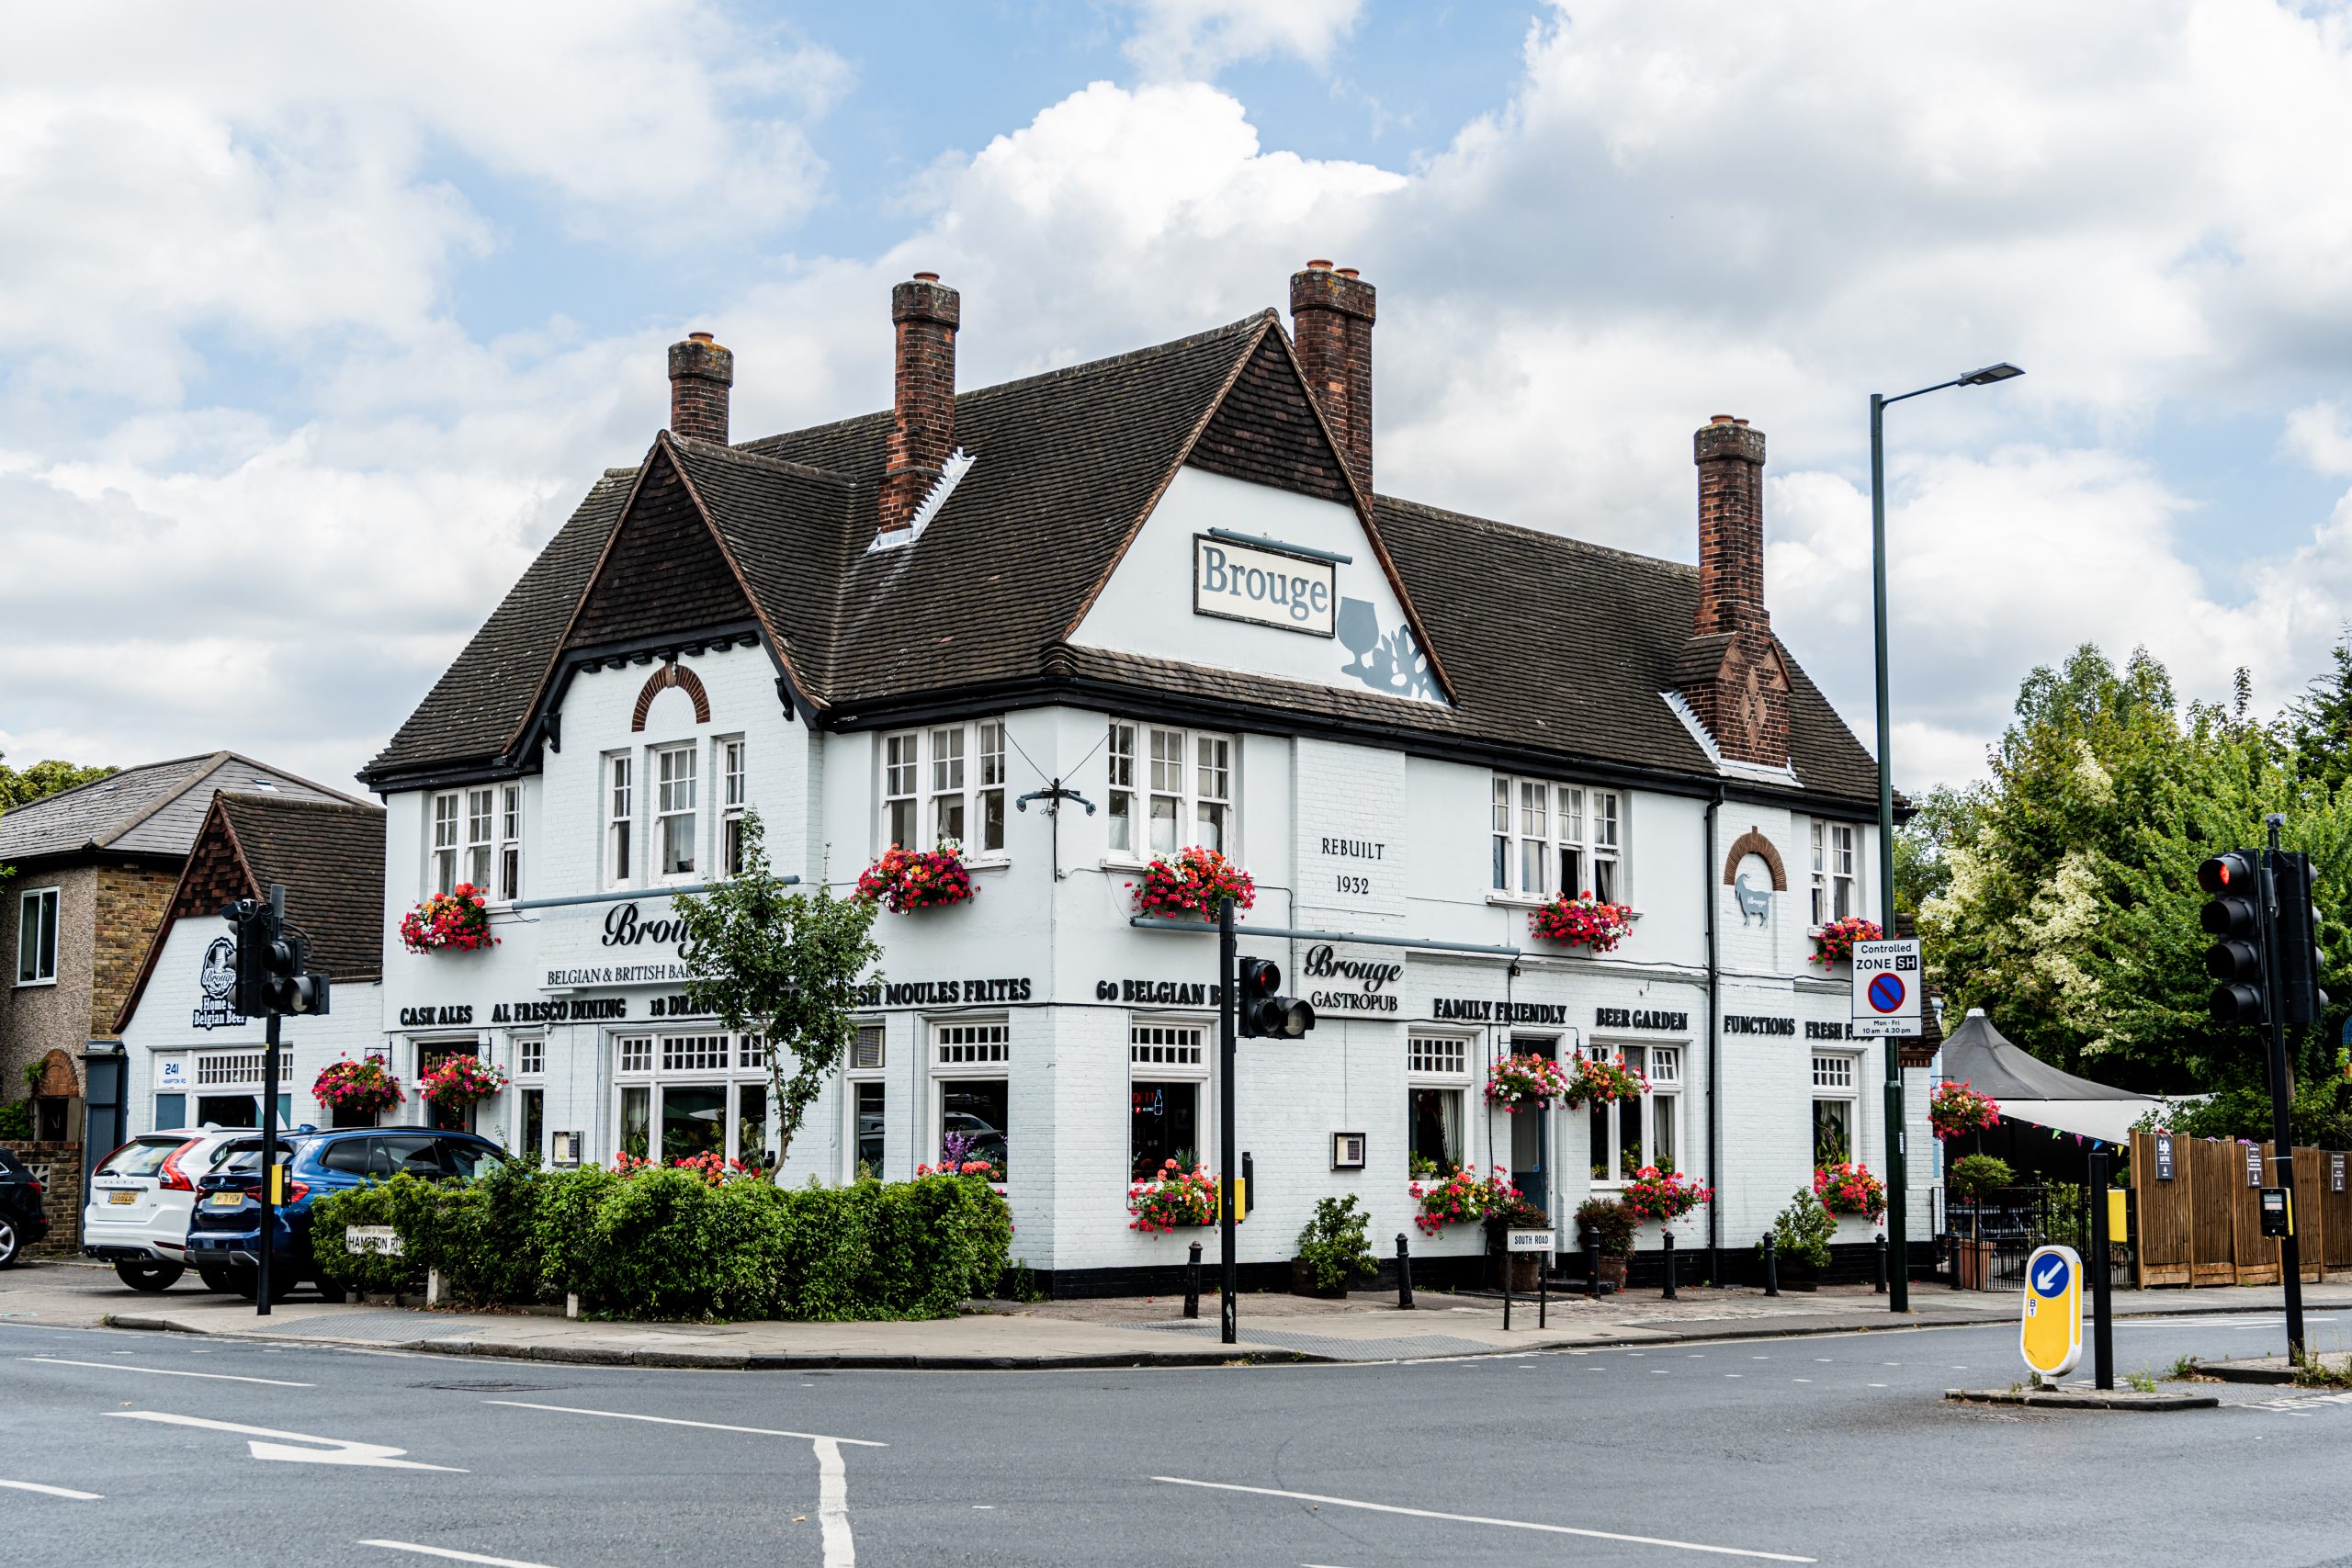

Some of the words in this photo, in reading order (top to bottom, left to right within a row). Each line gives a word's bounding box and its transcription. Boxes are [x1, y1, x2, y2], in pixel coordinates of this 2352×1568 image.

[1203, 546, 1328, 621] Brouge
[1322, 838, 1385, 860] REBUILT
[1337, 875, 1369, 895] 1932
[1861, 943, 1911, 953] Controlled
[1304, 944, 1403, 993] Brouge
[1856, 958, 1891, 969] ZONE
[1897, 957, 1916, 969] SH
[548, 968, 600, 986] BELGIAN
[603, 969, 613, 982] &
[615, 964, 665, 981] BRITISH
[885, 981, 959, 1006] MOULES
[963, 977, 1031, 1002] FRITES
[1096, 980, 1118, 1000] 60
[1123, 979, 1205, 1005] BELGIAN
[1311, 991, 1398, 1011] GASTROPUB
[203, 998, 226, 1010] Home
[492, 1003, 511, 1022] AL
[514, 1001, 568, 1021] FRESCO
[570, 998, 627, 1020] DINING
[650, 998, 665, 1016] 18
[1433, 998, 1492, 1021] FAMILY
[1495, 1001, 1567, 1024] FRIENDLY
[194, 1010, 225, 1027] Belgian
[400, 1007, 435, 1026] CASK
[437, 1005, 473, 1025] ALES
[1596, 1008, 1631, 1027] BEER
[1633, 1010, 1689, 1030] GARDEN
[1724, 1015, 1795, 1036] FUNCTIONS
[1805, 1021, 1843, 1040] FRESH
[165, 1063, 179, 1075] 241
[348, 1235, 388, 1249] HAMPTON
[1514, 1235, 1532, 1245] SOUTH
[1534, 1235, 1549, 1245] ROAD
[2030, 1298, 2036, 1307] B
[2030, 1308, 2034, 1316] 1
